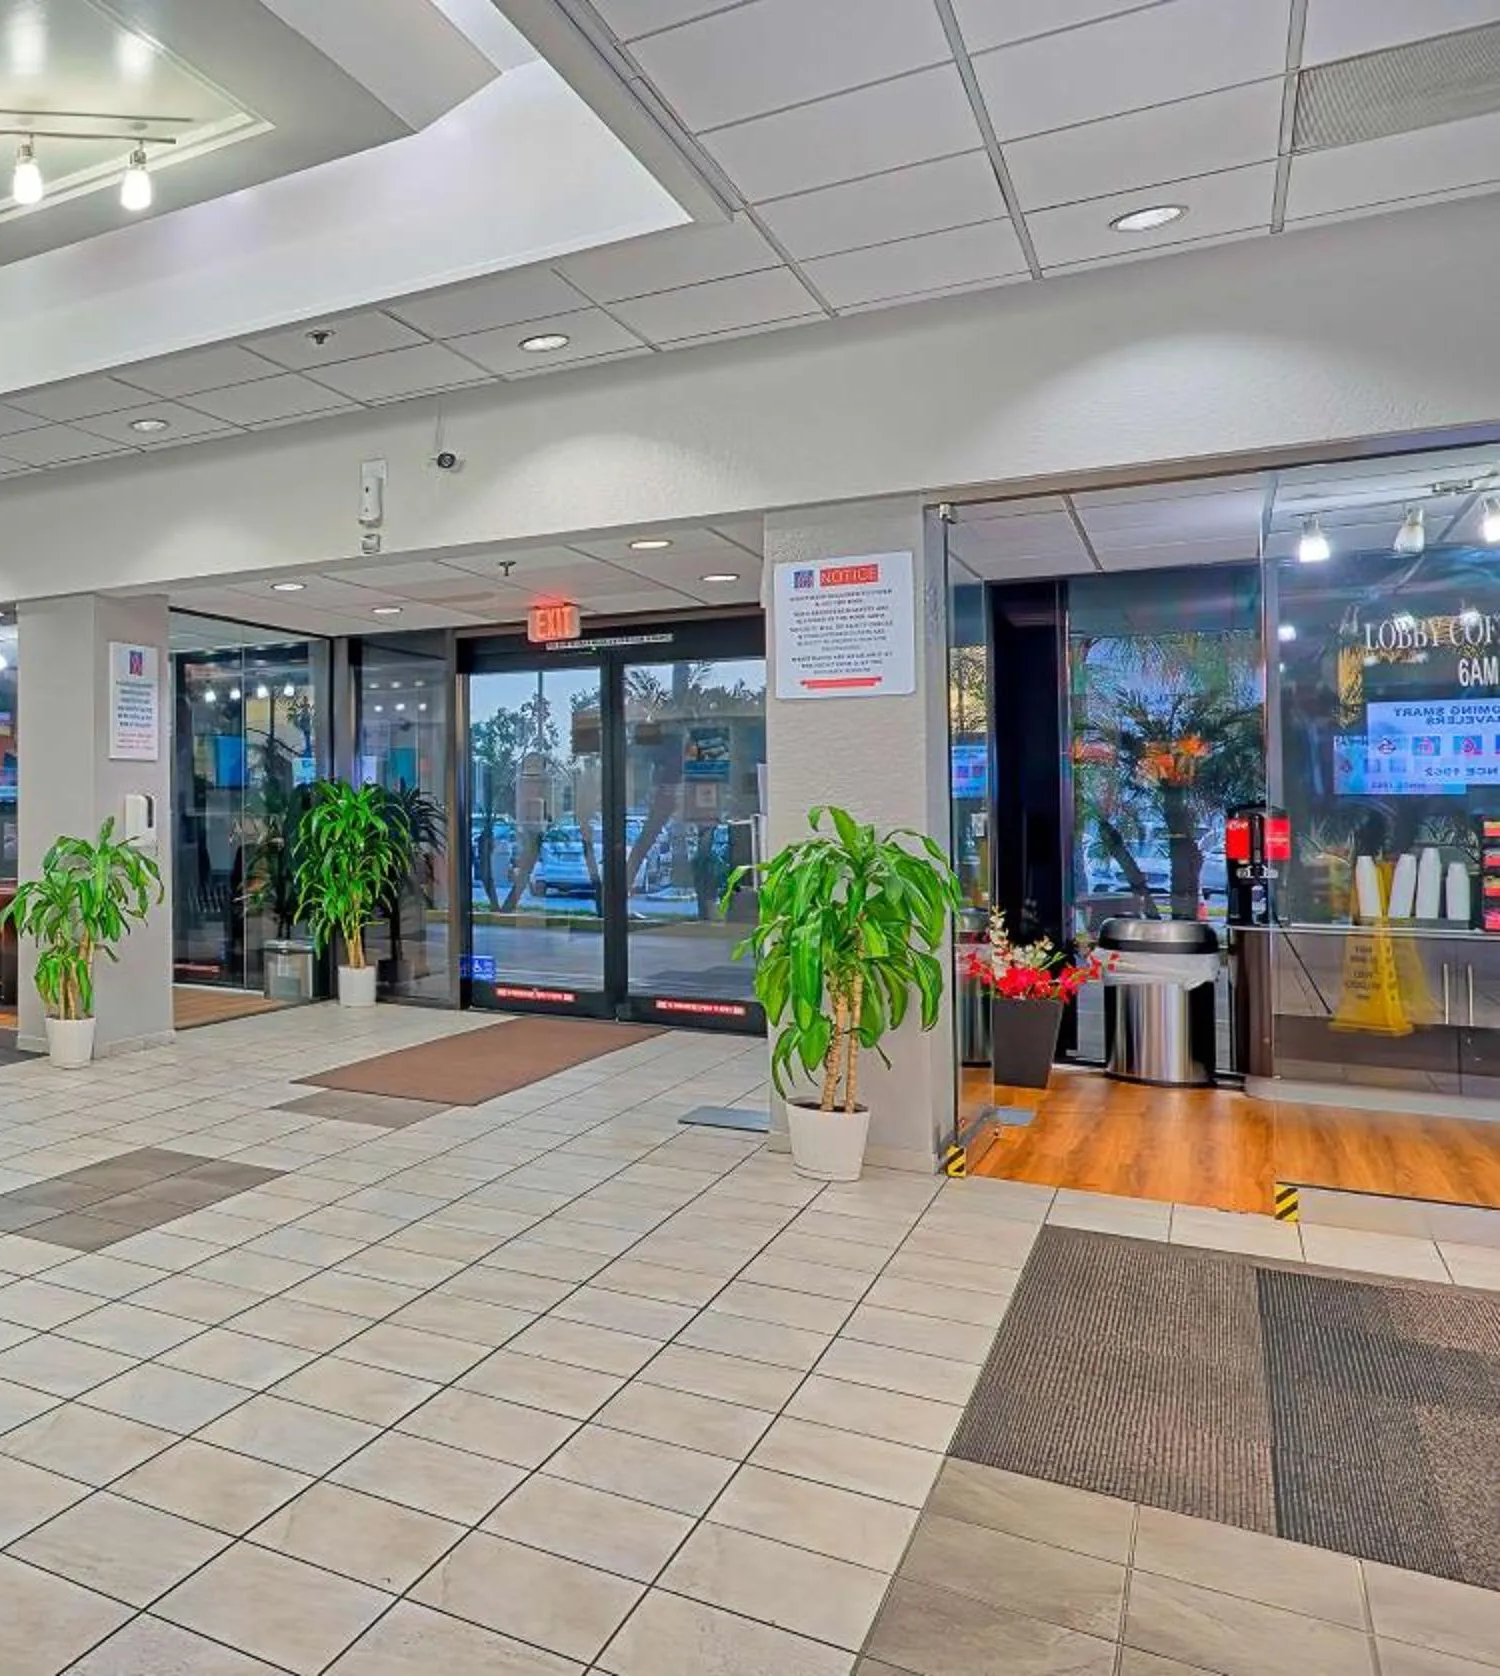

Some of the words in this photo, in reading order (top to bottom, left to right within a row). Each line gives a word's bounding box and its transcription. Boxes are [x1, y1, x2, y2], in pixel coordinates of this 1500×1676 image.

[821, 567, 878, 585] NOTICE
[536, 608, 572, 637] EXIT
[1365, 616, 1440, 650] LOBBY
[1459, 656, 1499, 687] 6AM
